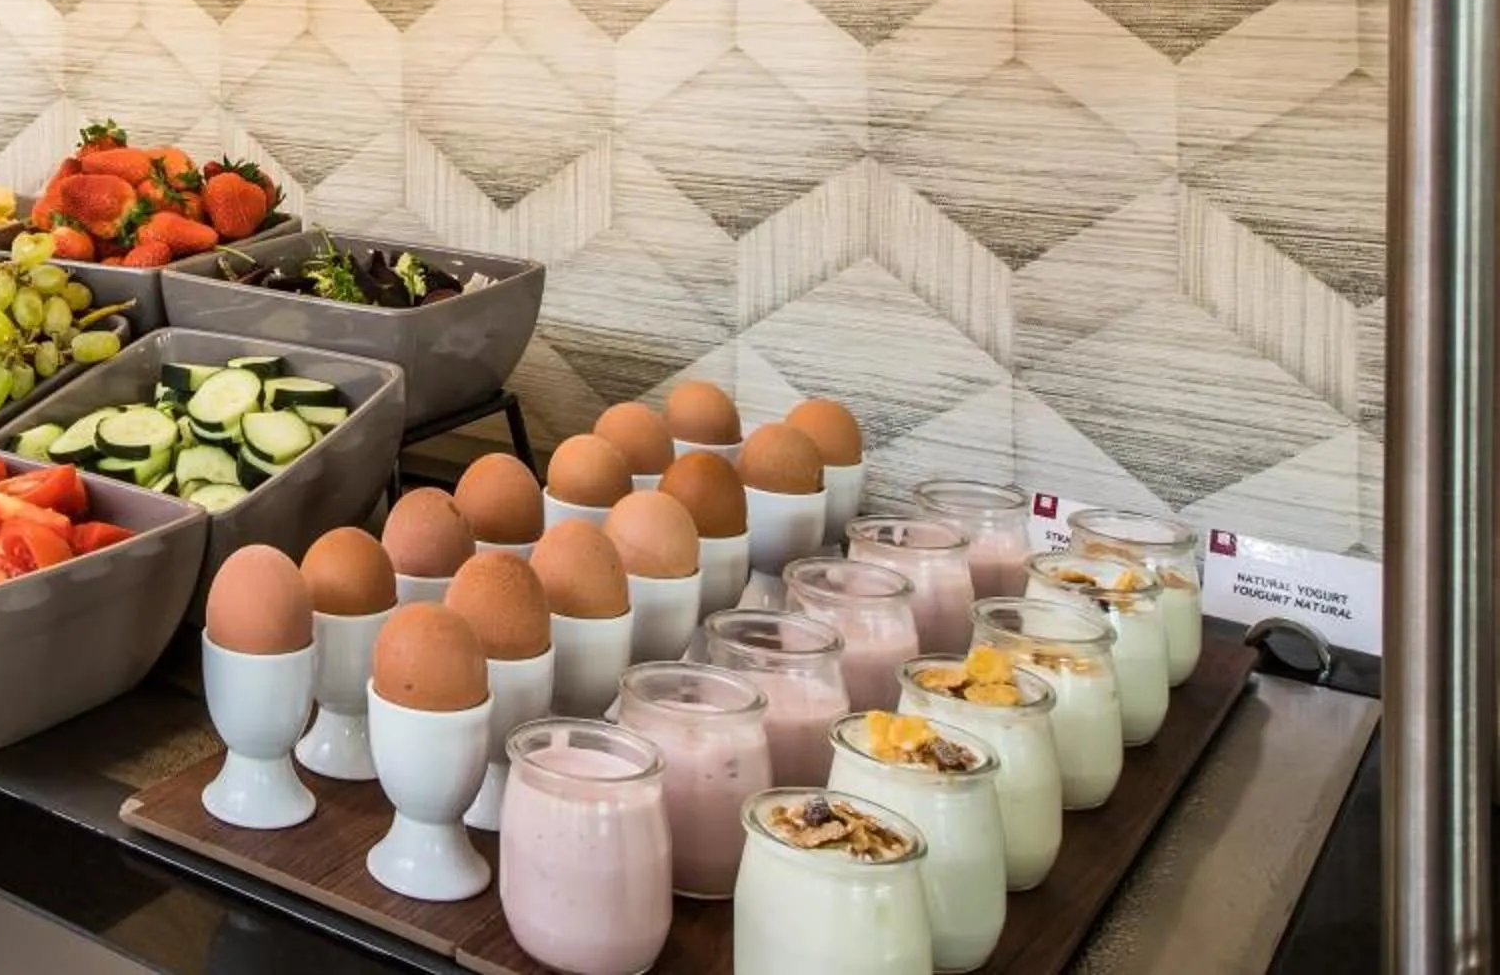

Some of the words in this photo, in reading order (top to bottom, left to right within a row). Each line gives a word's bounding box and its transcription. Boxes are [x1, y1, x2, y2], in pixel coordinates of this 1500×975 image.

[1233, 584, 1292, 606] YOUGURT
[1294, 598, 1353, 620] NATURAL
[1236, 572, 1291, 592] NATURAL
[1297, 584, 1350, 605] YOGURT
